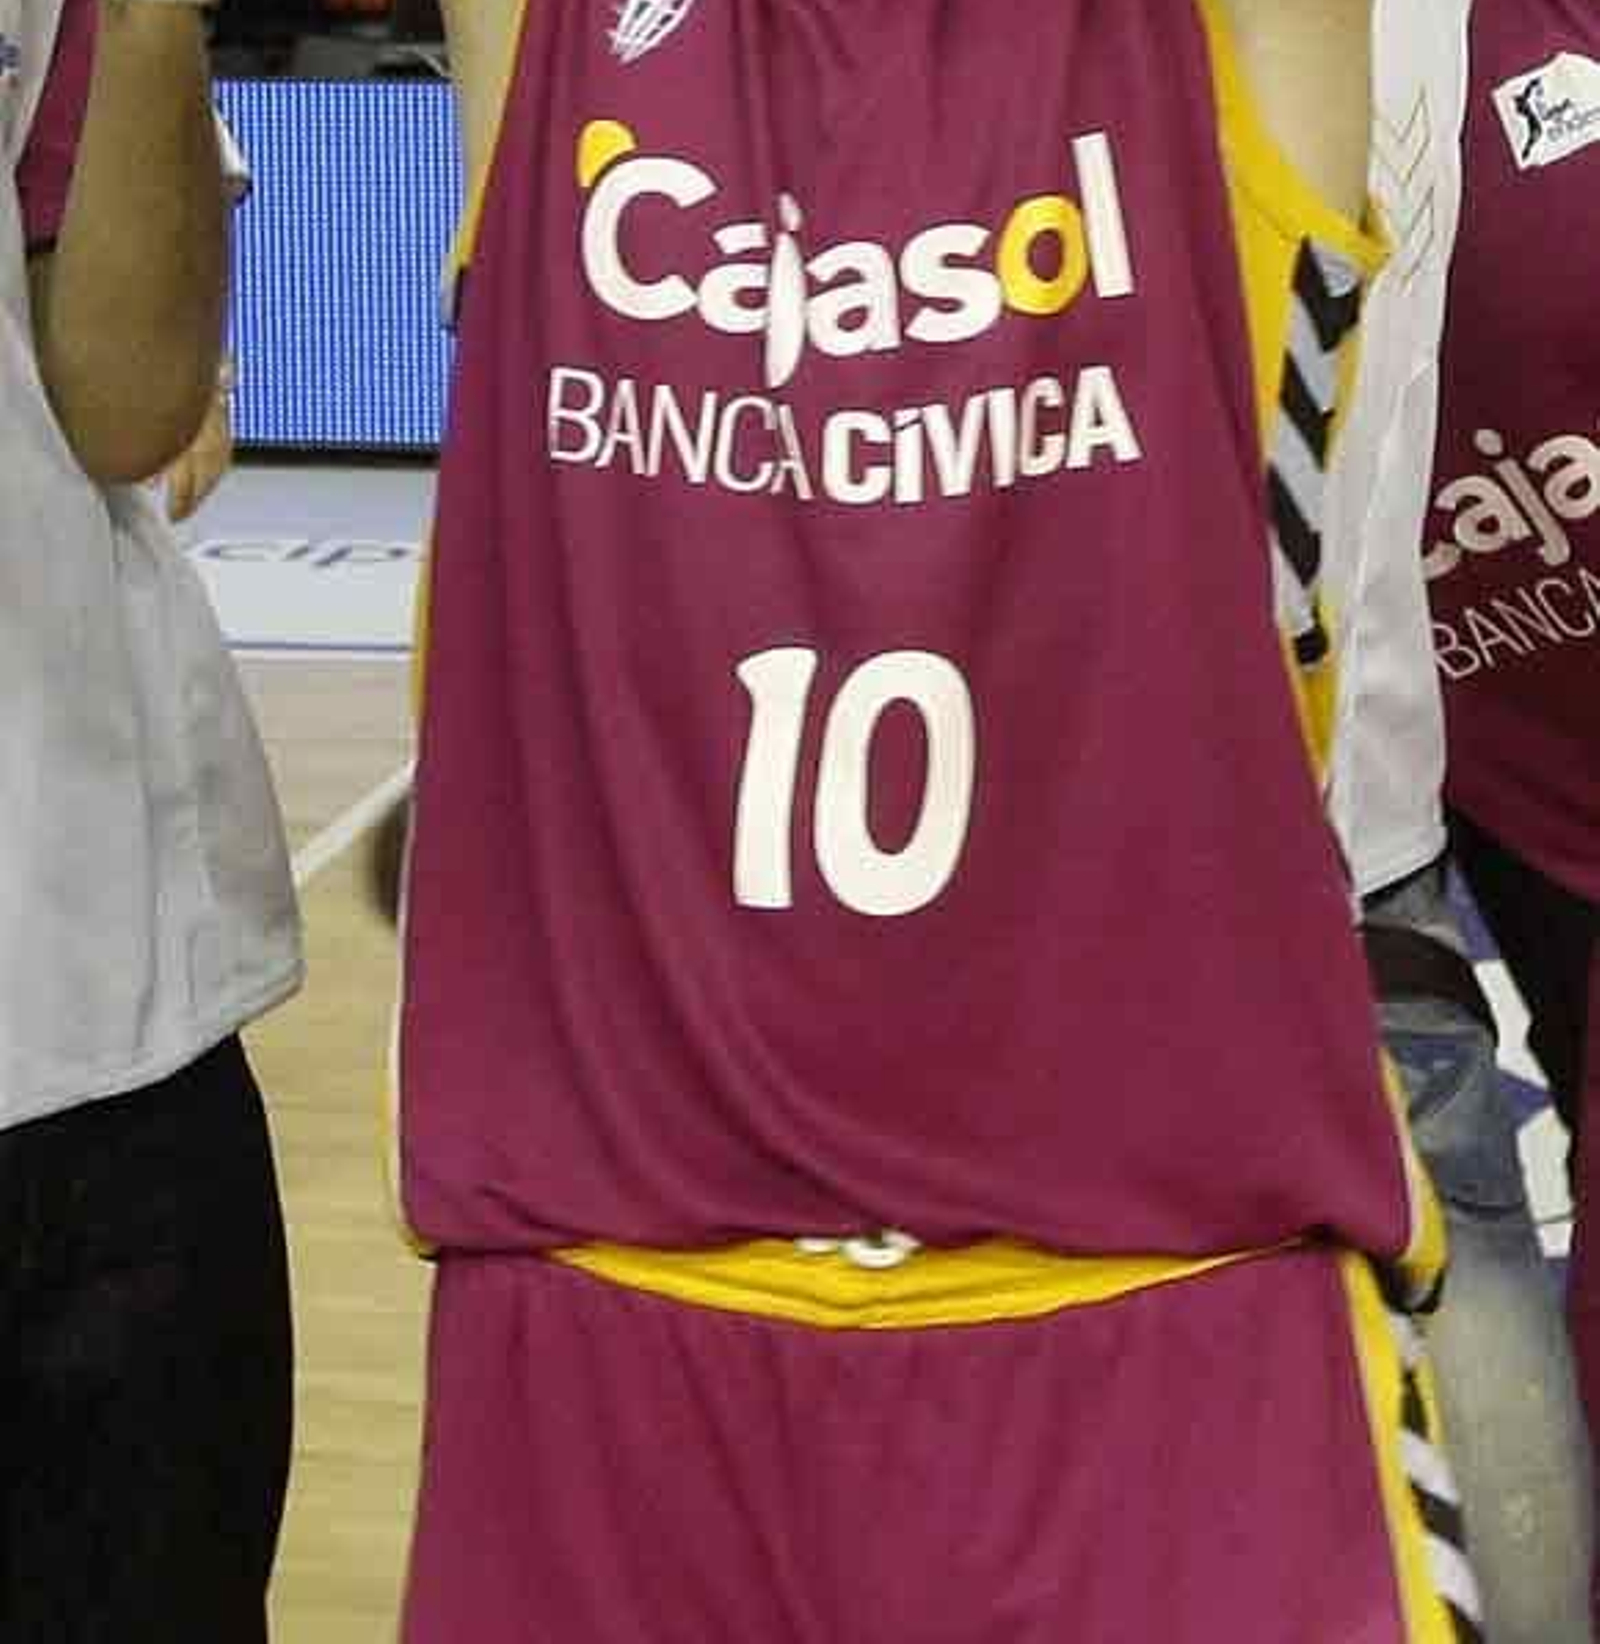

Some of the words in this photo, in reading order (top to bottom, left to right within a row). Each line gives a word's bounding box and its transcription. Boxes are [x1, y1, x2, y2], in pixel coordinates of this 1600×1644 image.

[581, 131, 1135, 389] Cajasol
[547, 365, 812, 501] BANCA
[733, 647, 977, 916] 10
